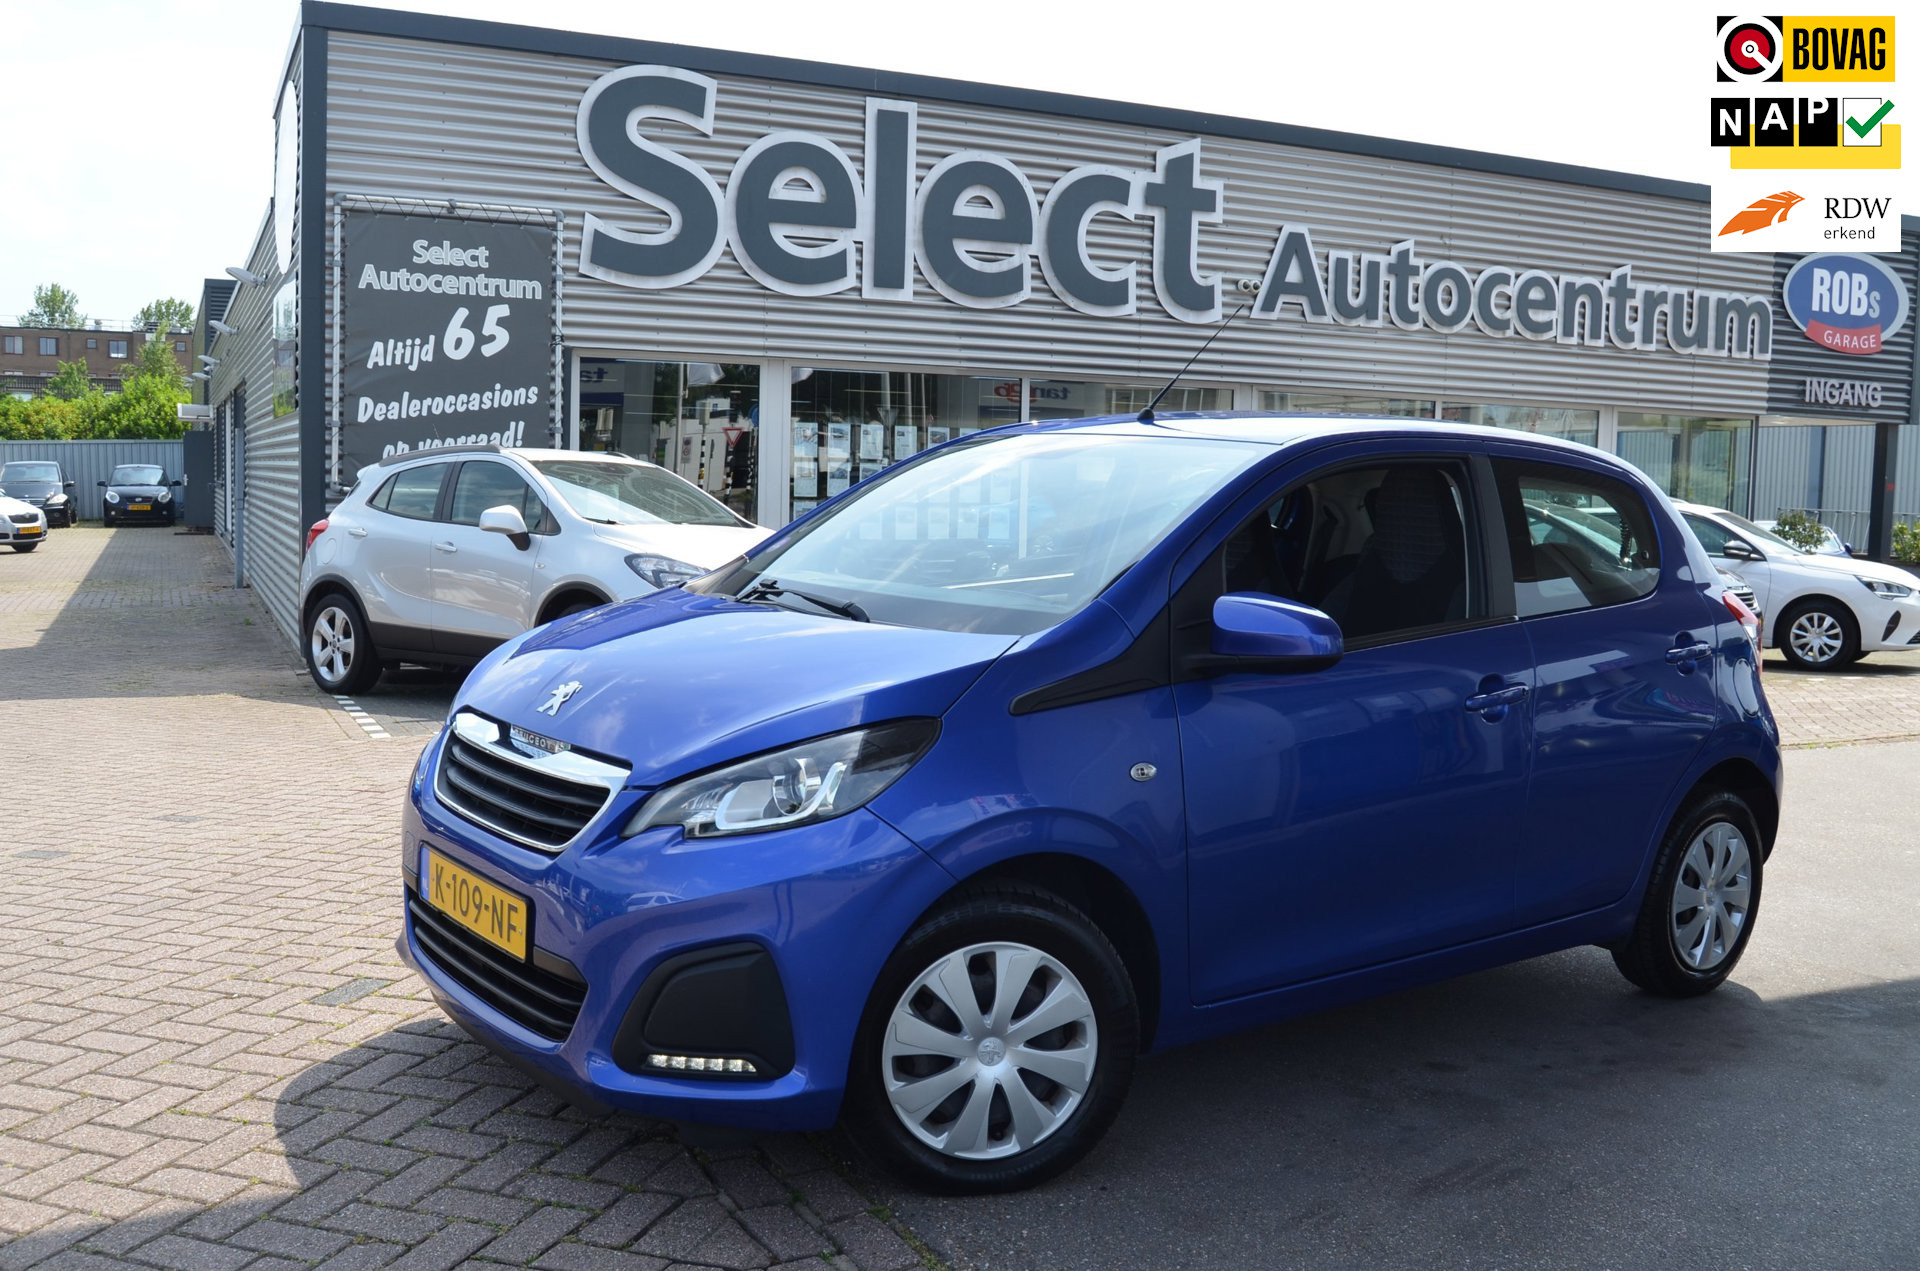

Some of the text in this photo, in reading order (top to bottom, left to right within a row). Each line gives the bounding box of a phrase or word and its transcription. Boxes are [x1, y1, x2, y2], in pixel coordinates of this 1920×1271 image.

[576, 64, 1775, 361] Select Autocentrum
[412, 239, 489, 268] Select
[358, 264, 542, 300] Autocentrum
[1811, 267, 1881, 319] ROBs
[366, 303, 511, 372] Altijd 65
[1823, 330, 1877, 349] GARAGE
[357, 383, 539, 423] Dealeroccasions
[1804, 377, 1883, 408] INGANG
[435, 863, 518, 943] K-109-NF
